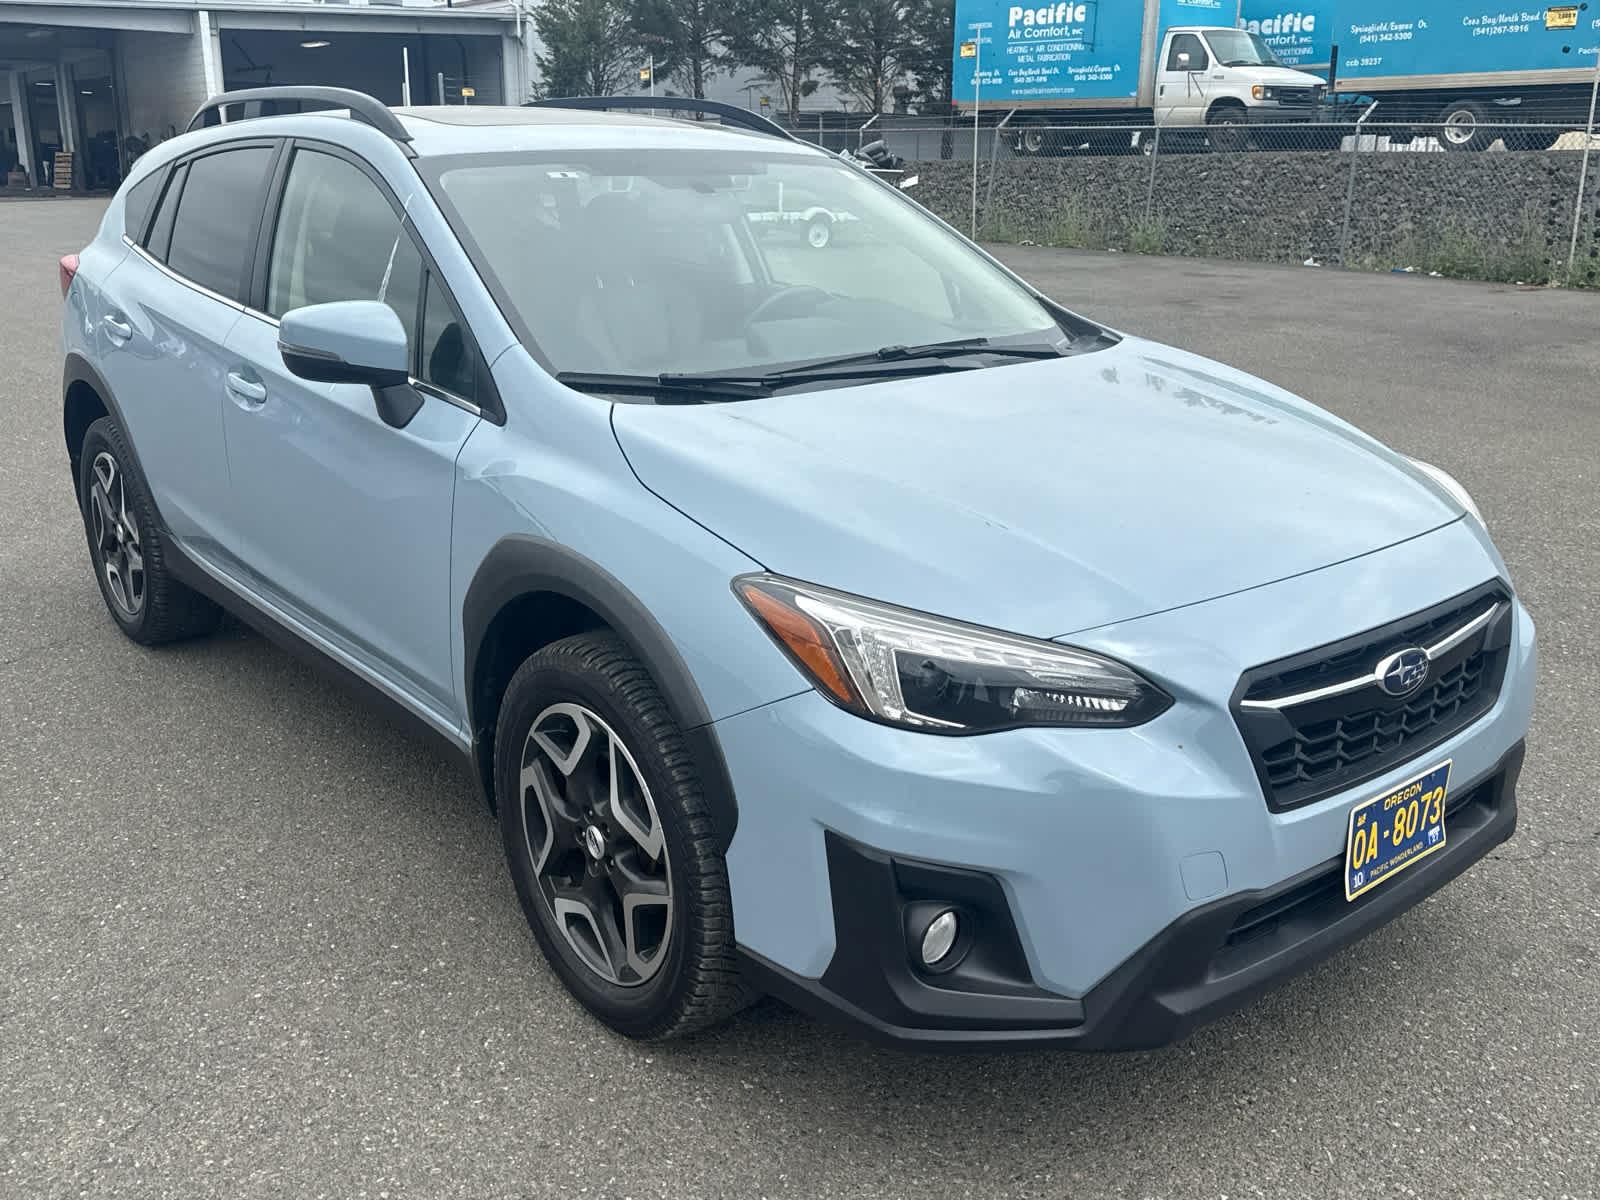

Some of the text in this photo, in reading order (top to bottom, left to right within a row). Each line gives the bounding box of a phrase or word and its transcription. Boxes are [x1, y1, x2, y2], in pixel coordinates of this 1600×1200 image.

[1009, 1, 1086, 27] Pacific
[1463, 16, 1480, 26] Coos
[1481, 13, 1519, 26] Bay/North
[1521, 11, 1540, 22] Bend
[1008, 28, 1021, 40] Air
[1023, 25, 1071, 39] Comfort,
[1264, 34, 1298, 45] mfort,
[1360, 34, 1378, 44] (541)
[1007, 43, 1084, 55] HEATING AIR CONDITIONING
[1017, 53, 1072, 63] METAL FABRICATION
[1384, 780, 1423, 811] OREGON
[1370, 841, 1424, 879] PACIFIC WONDERLAND
[1353, 871, 1364, 889] 10
